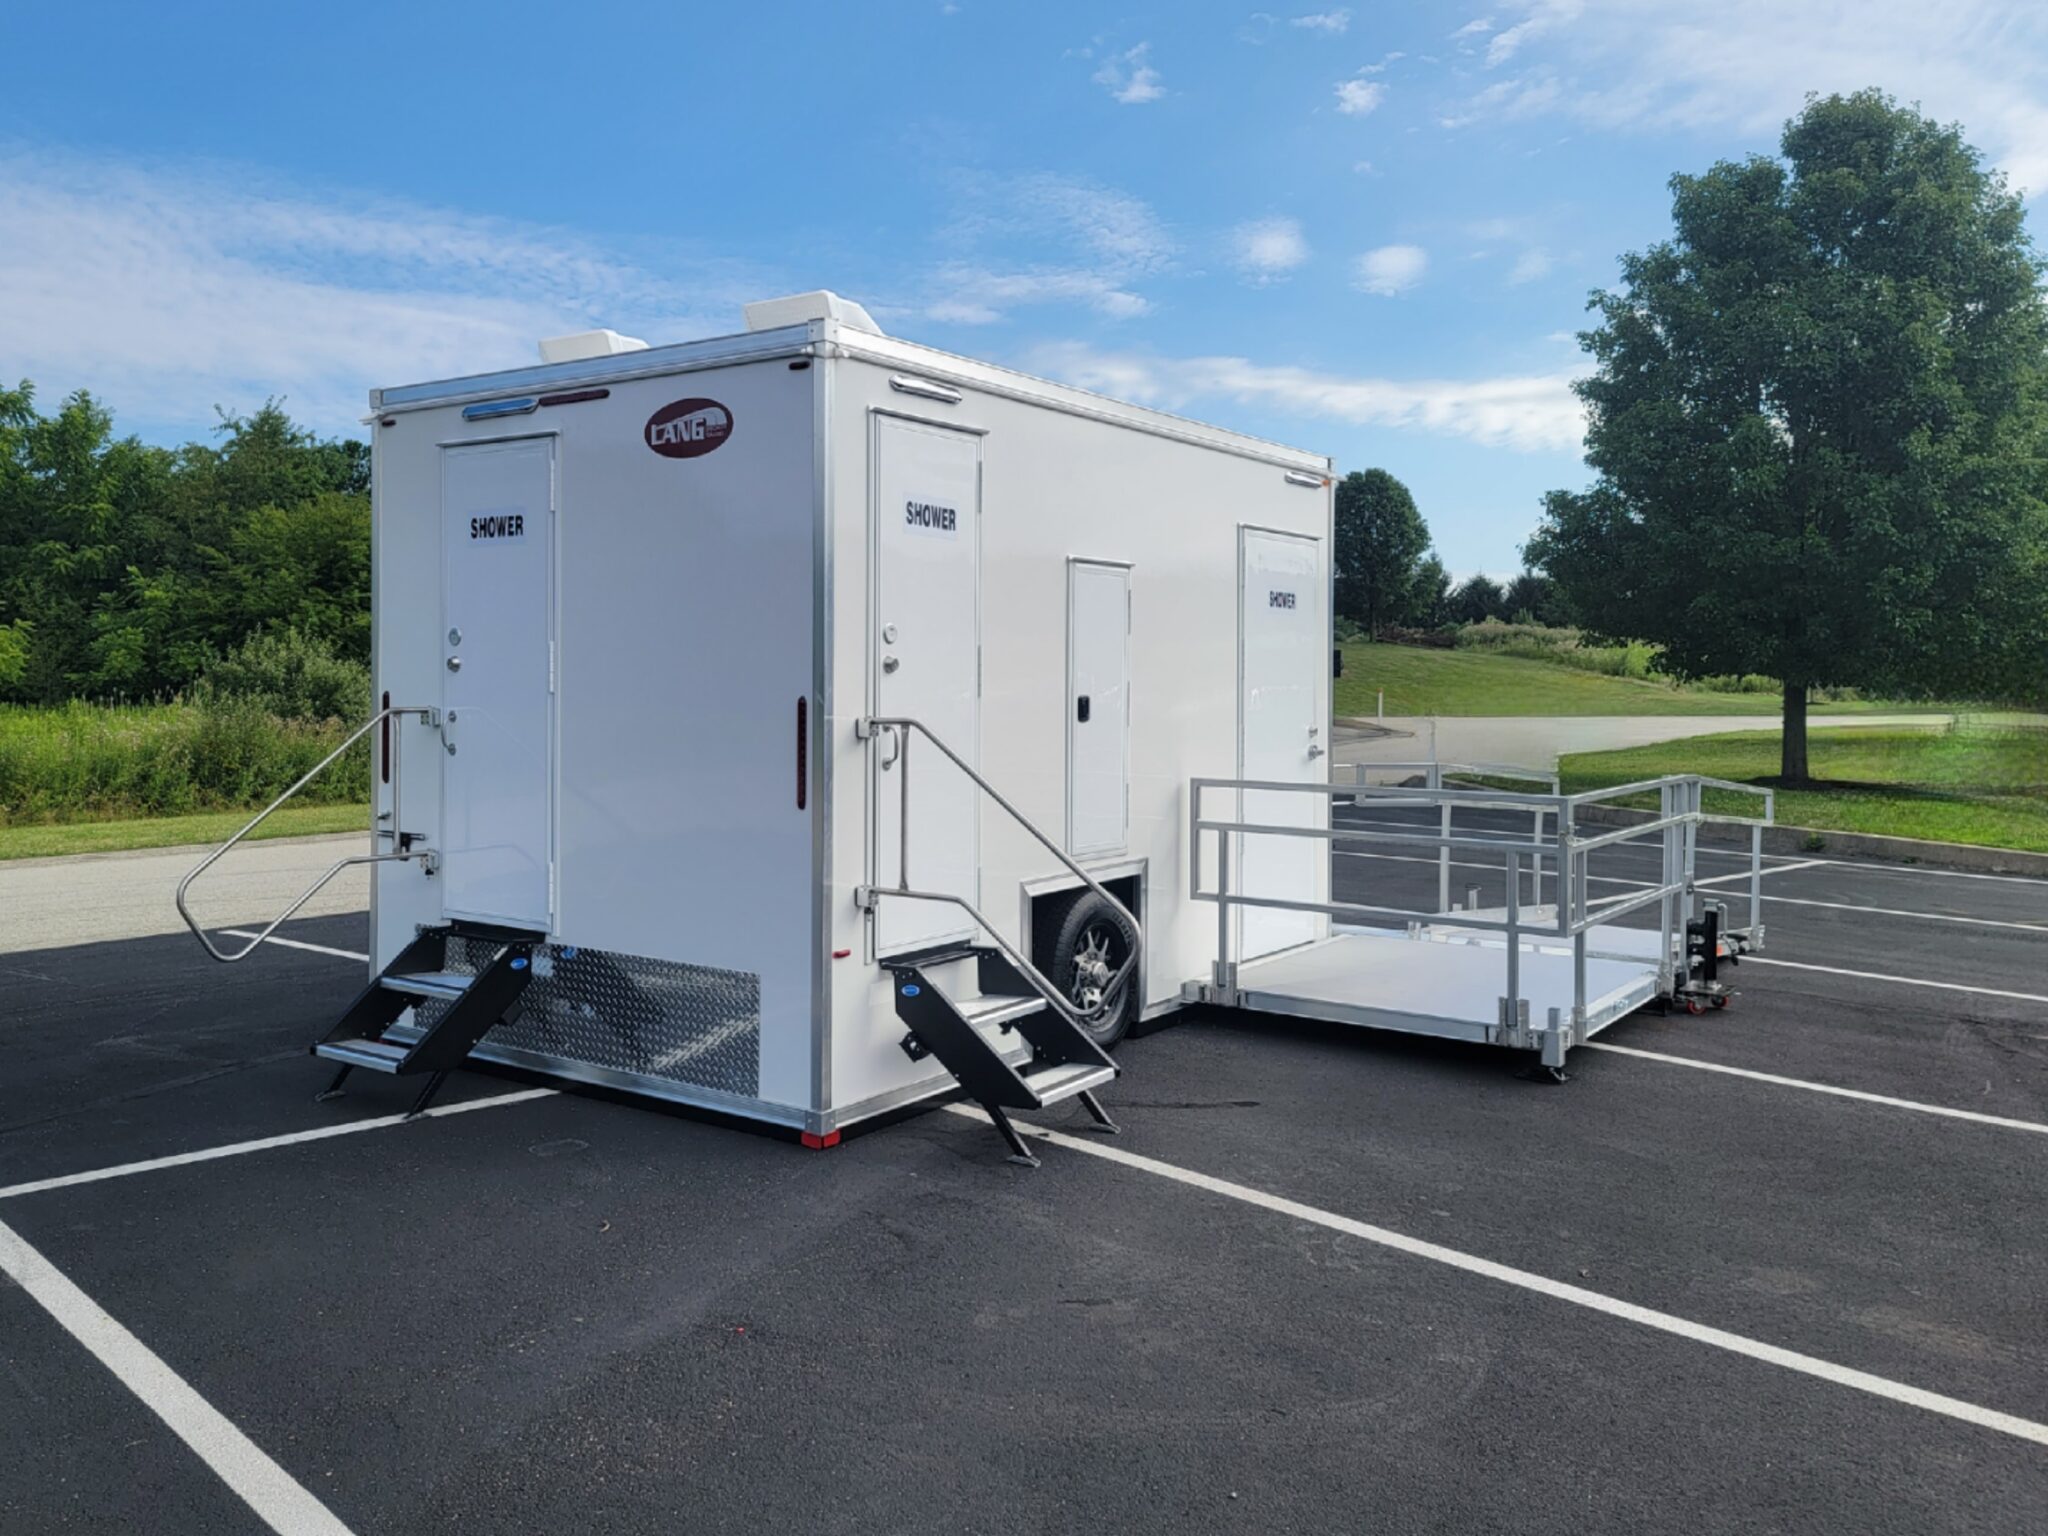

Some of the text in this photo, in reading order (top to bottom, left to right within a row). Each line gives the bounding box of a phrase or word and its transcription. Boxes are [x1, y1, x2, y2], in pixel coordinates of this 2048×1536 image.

[651, 417, 705, 445] LANG
[471, 515, 523, 539] SHOWER
[906, 501, 956, 531] SHOWER
[1270, 591, 1296, 609] SHOWER
